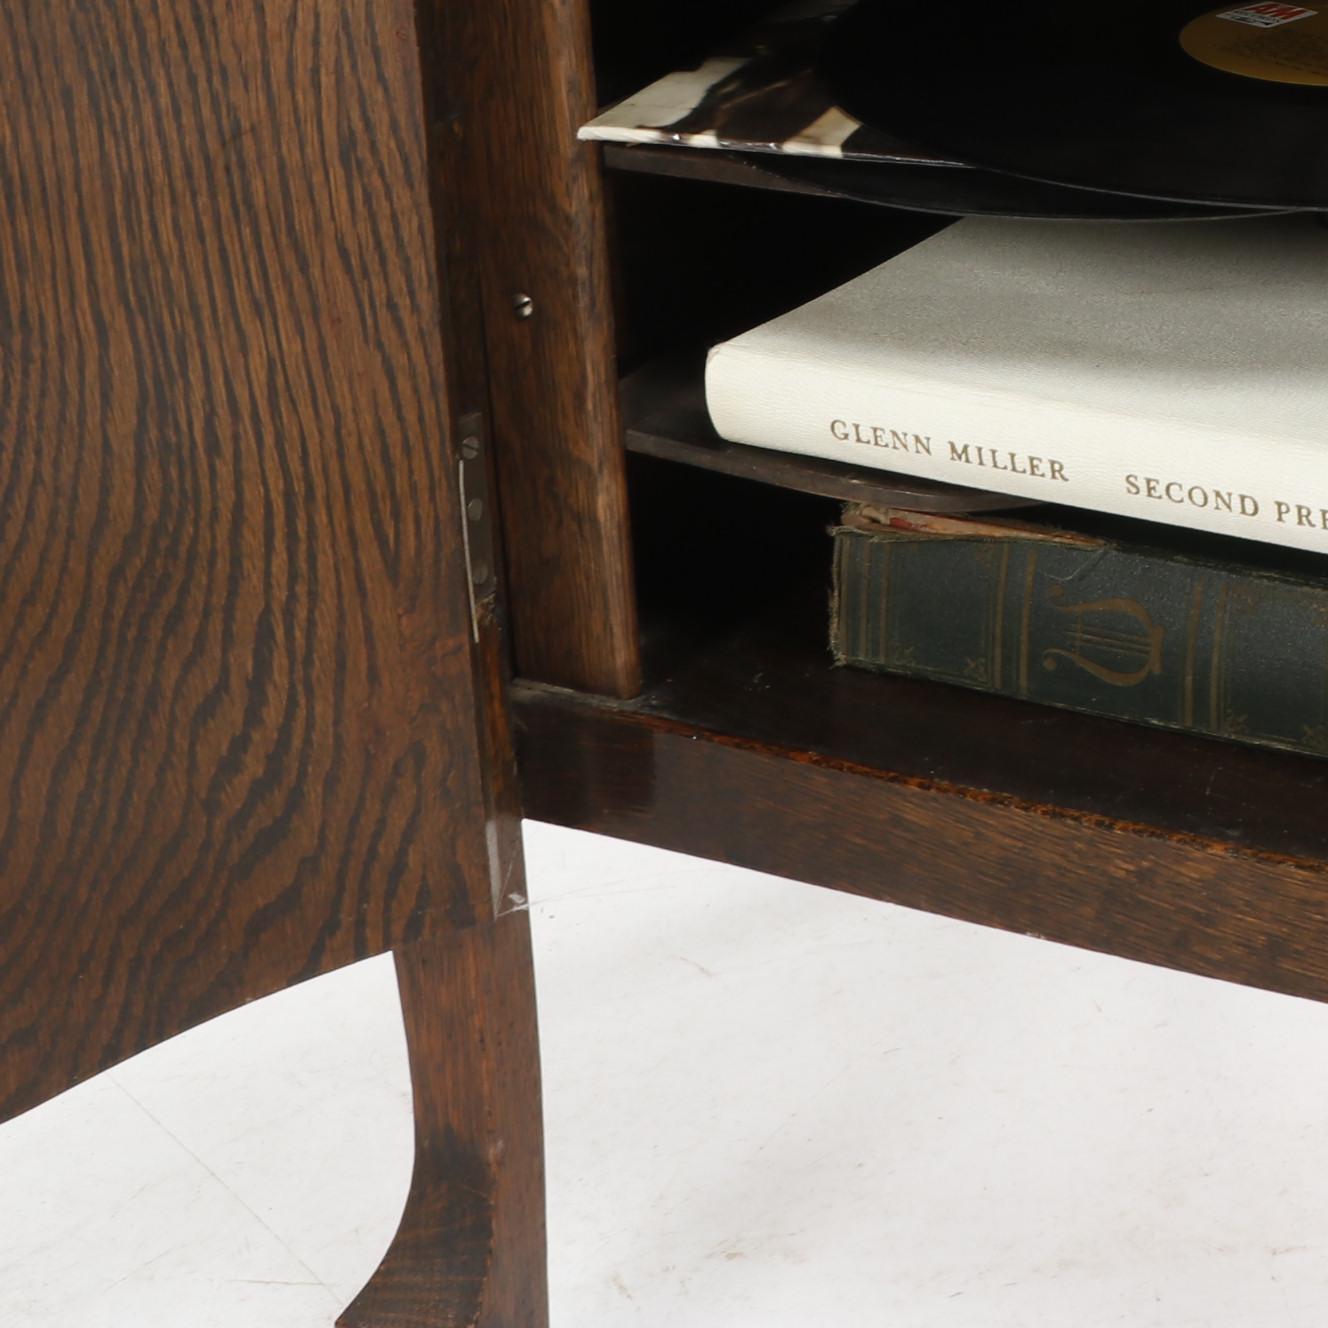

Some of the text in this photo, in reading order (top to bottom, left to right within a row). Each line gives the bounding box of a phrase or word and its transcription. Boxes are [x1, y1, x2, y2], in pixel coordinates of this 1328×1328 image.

[829, 419, 932, 456] GLENN
[948, 441, 1069, 482] MILLER
[1125, 474, 1259, 517] SECOND
